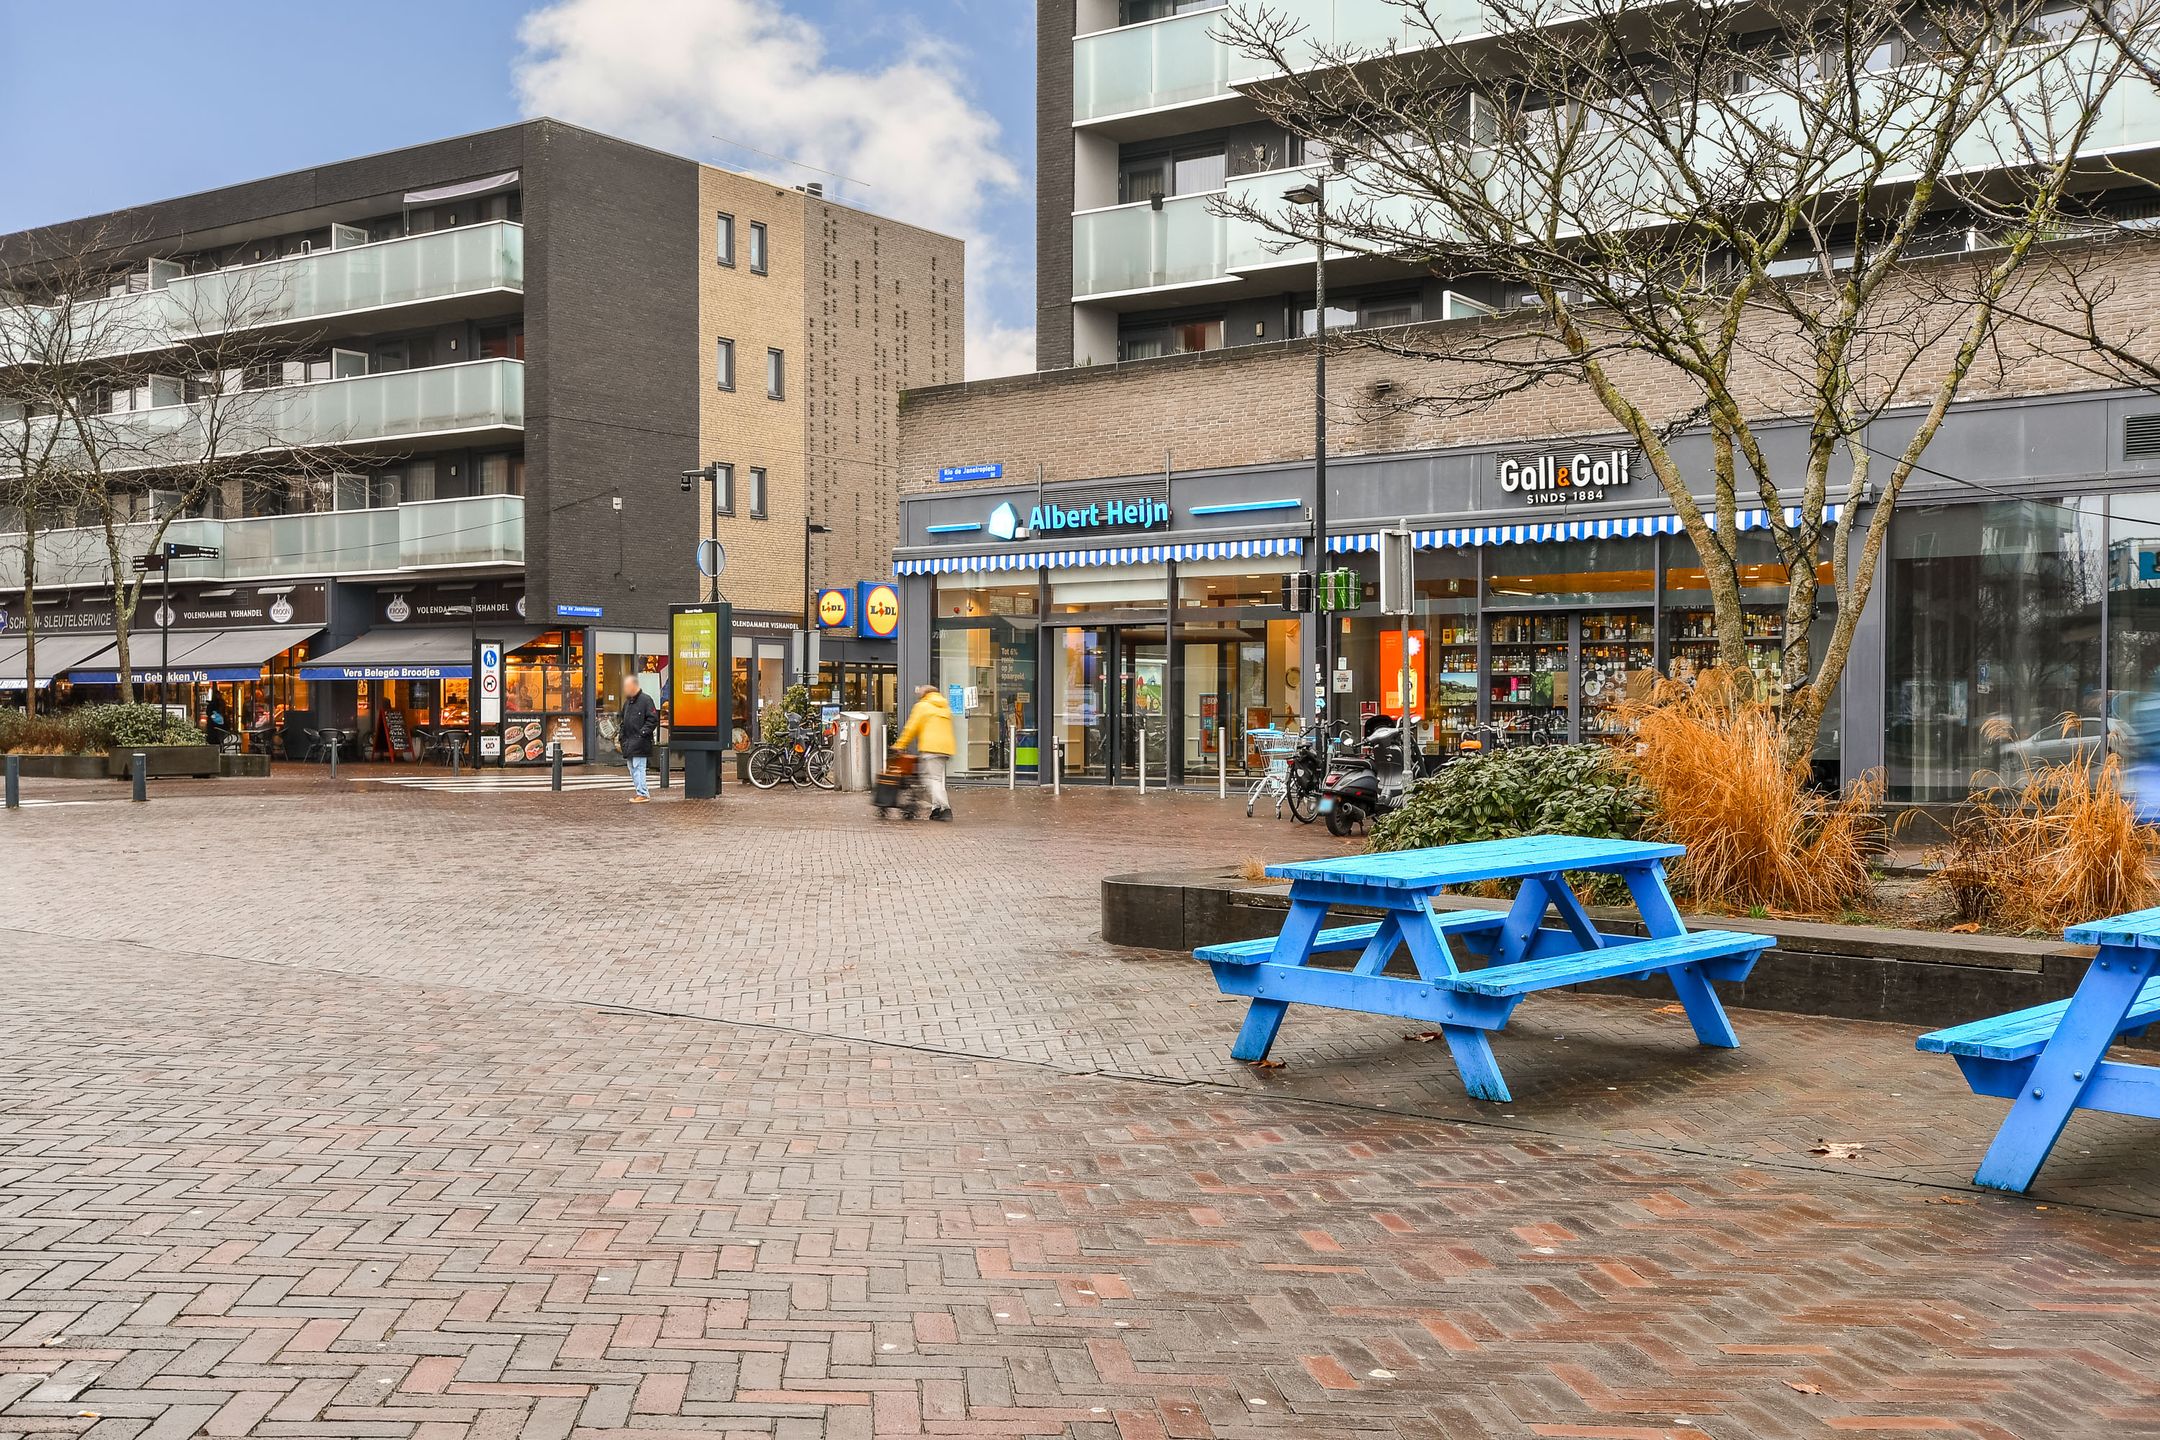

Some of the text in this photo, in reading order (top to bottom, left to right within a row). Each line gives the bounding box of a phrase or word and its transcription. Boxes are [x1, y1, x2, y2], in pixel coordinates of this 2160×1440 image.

[963, 465, 996, 474] Janeiroplein
[1526, 490, 1603, 504] SINDS 1884
[1029, 498, 1169, 531] Albert Heijn
[475, 603, 510, 612] ISHANDEL
[183, 609, 263, 619] VOLENDAMMER VISHANDEL
[44, 613, 112, 628] SLEUTELSERVICE
[771, 622, 799, 630] VISHANDEL
[144, 672, 190, 682] Gebkken
[192, 671, 208, 681] Vis
[343, 668, 440, 678] Vers Belegde Broodjes
